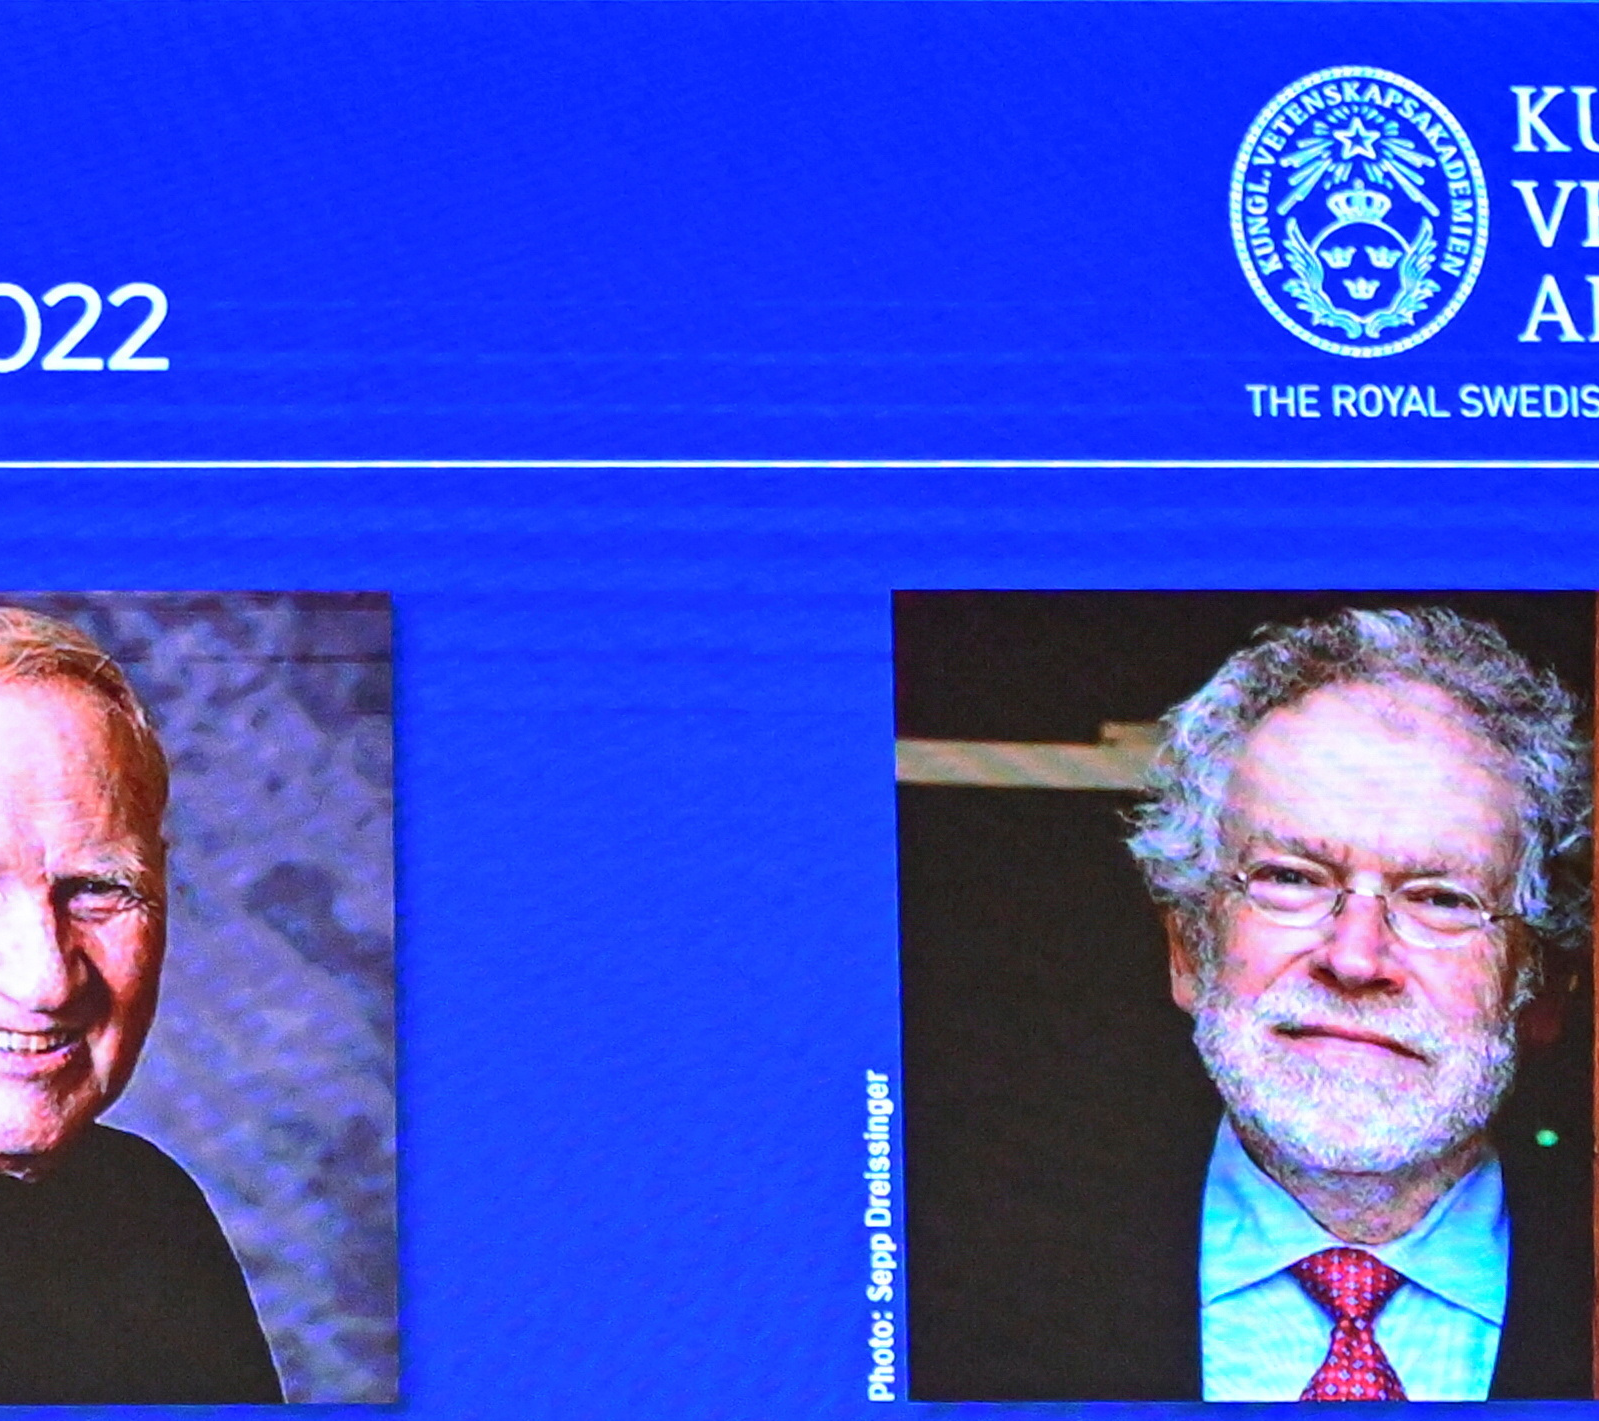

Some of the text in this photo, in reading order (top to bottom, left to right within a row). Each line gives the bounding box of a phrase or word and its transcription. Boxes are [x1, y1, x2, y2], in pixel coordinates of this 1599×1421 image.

[1245, 80, 1473, 277] KUNGL. VETENSKAPSAKADEMIEN
[1247, 385, 1320, 417] THE
[1335, 385, 1450, 416] ROYAL
[864, 1071, 896, 1401] Photo: Sepp Dreissinger
